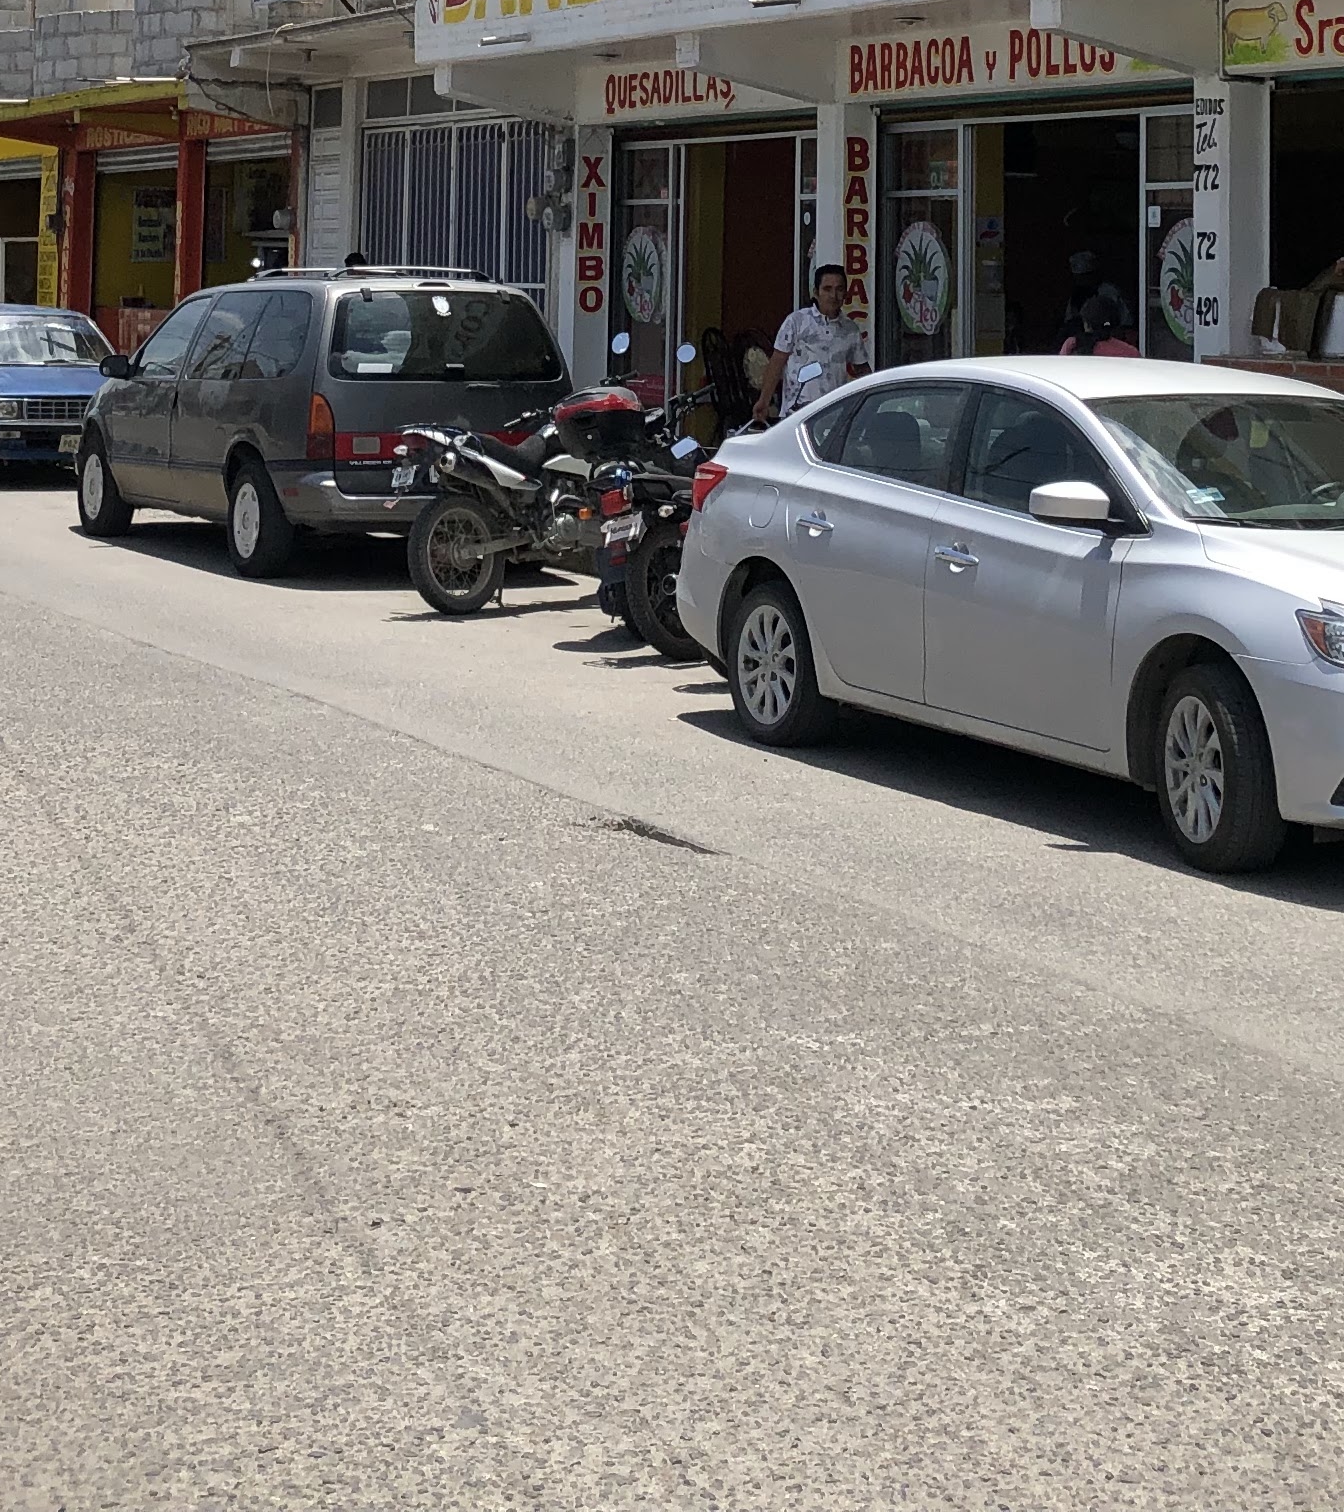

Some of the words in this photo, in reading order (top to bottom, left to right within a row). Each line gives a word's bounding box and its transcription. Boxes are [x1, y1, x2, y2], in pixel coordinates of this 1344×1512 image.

[847, 35, 975, 95] BARBACOA
[1194, 163, 1220, 192] 772
[577, 155, 607, 313] XIMBO
[1196, 231, 1217, 261] 72
[1195, 296, 1220, 327] 420
